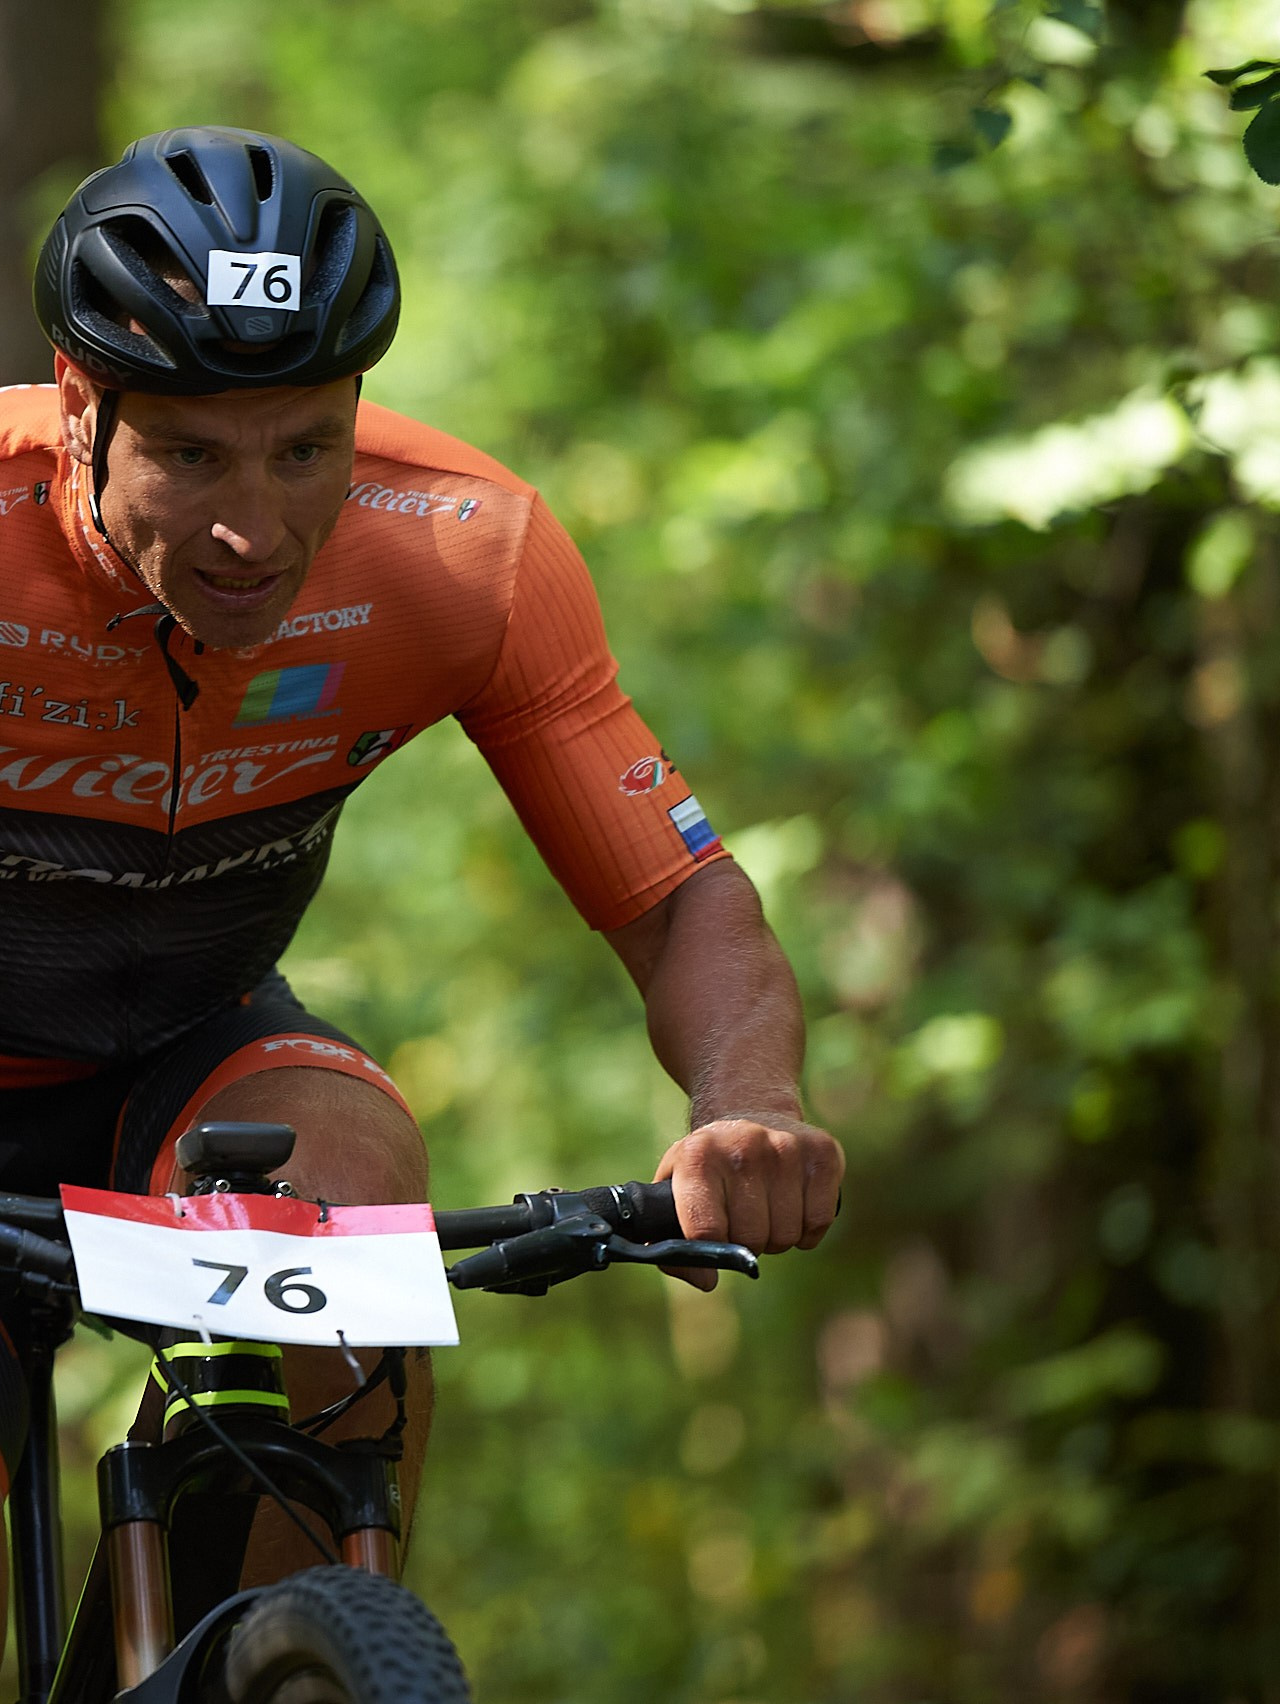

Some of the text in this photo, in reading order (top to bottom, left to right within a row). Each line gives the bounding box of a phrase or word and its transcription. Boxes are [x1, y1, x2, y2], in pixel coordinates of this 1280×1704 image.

[230, 261, 293, 304] 76
[39, 628, 153, 661] RUDY
[264, 602, 373, 645] ACTORY
[199, 734, 340, 765] TRIESTINA
[191, 1257, 328, 1315] 76
